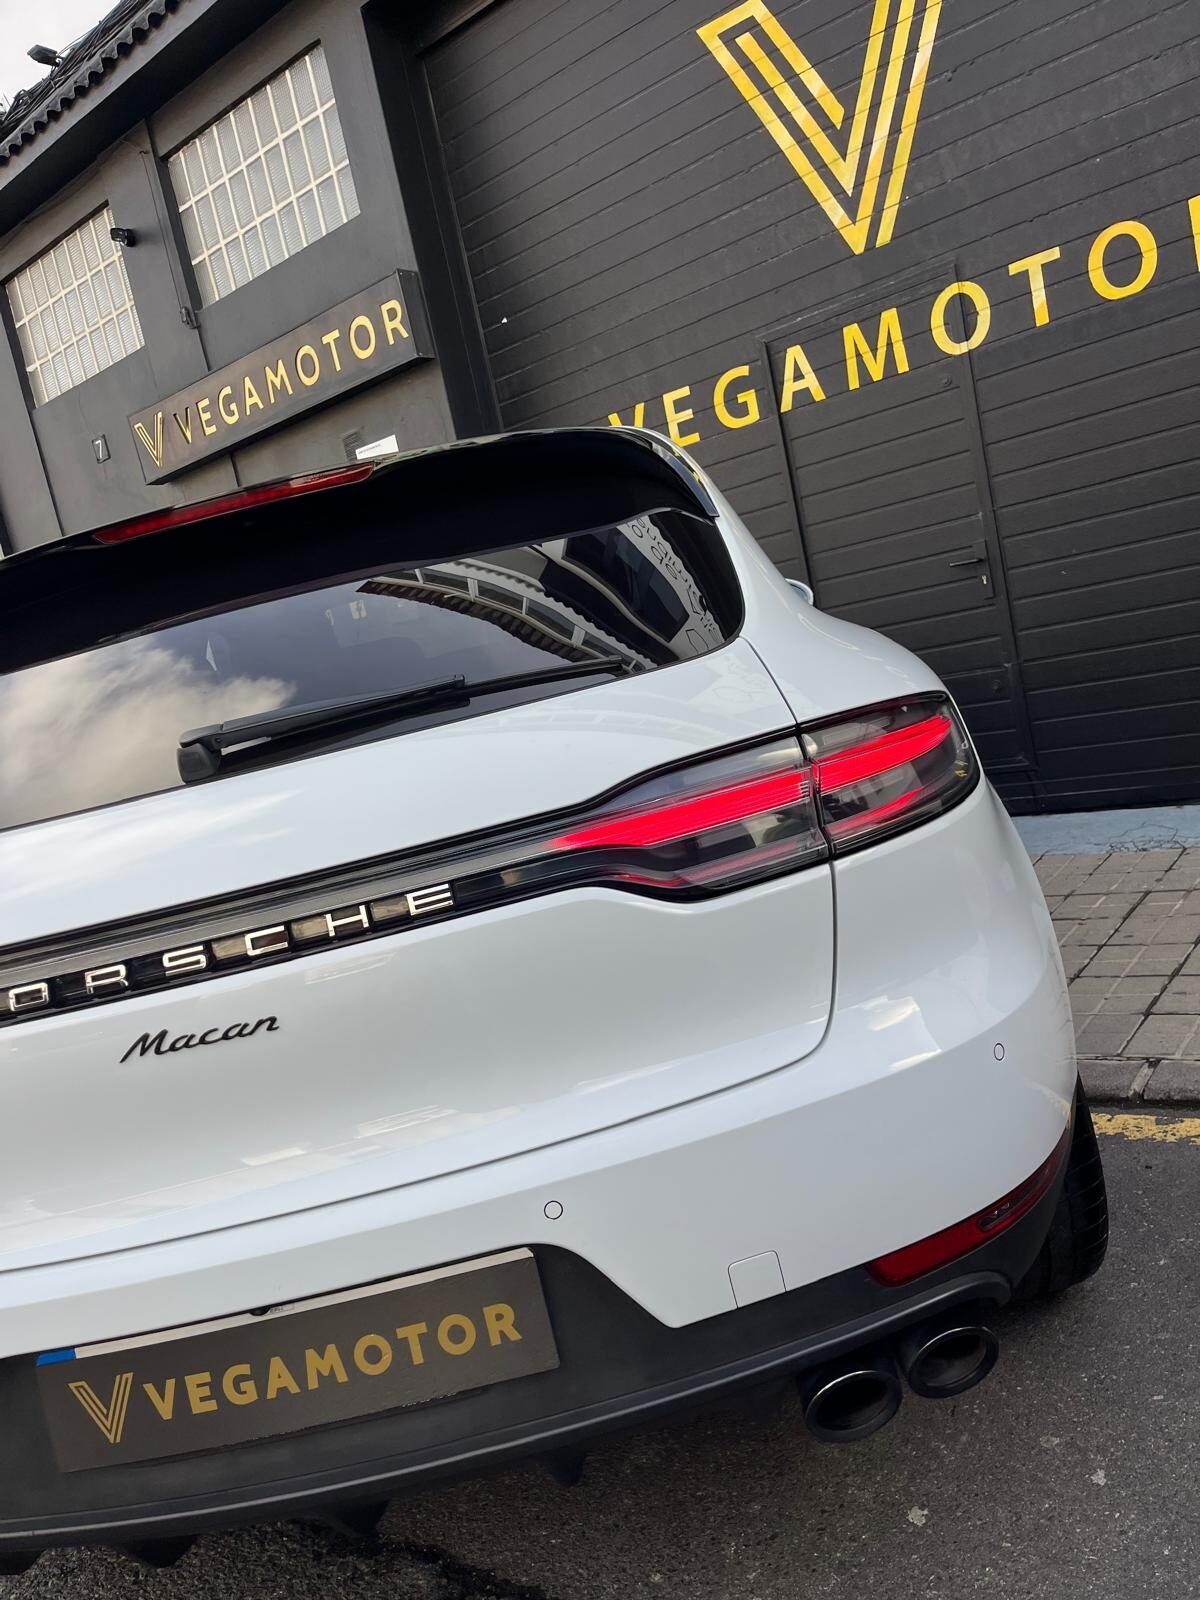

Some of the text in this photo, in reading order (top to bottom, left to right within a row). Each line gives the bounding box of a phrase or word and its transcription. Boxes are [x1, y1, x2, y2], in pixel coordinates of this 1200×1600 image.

[172, 299, 409, 444] VEGAMOTOR
[607, 195, 1200, 449] EGAMOTO
[94, 439, 102, 459] 7
[8, 883, 454, 1013] ORSCHE
[119, 1015, 279, 1064] Macan
[143, 1302, 523, 1421] VEGAMOTOR
